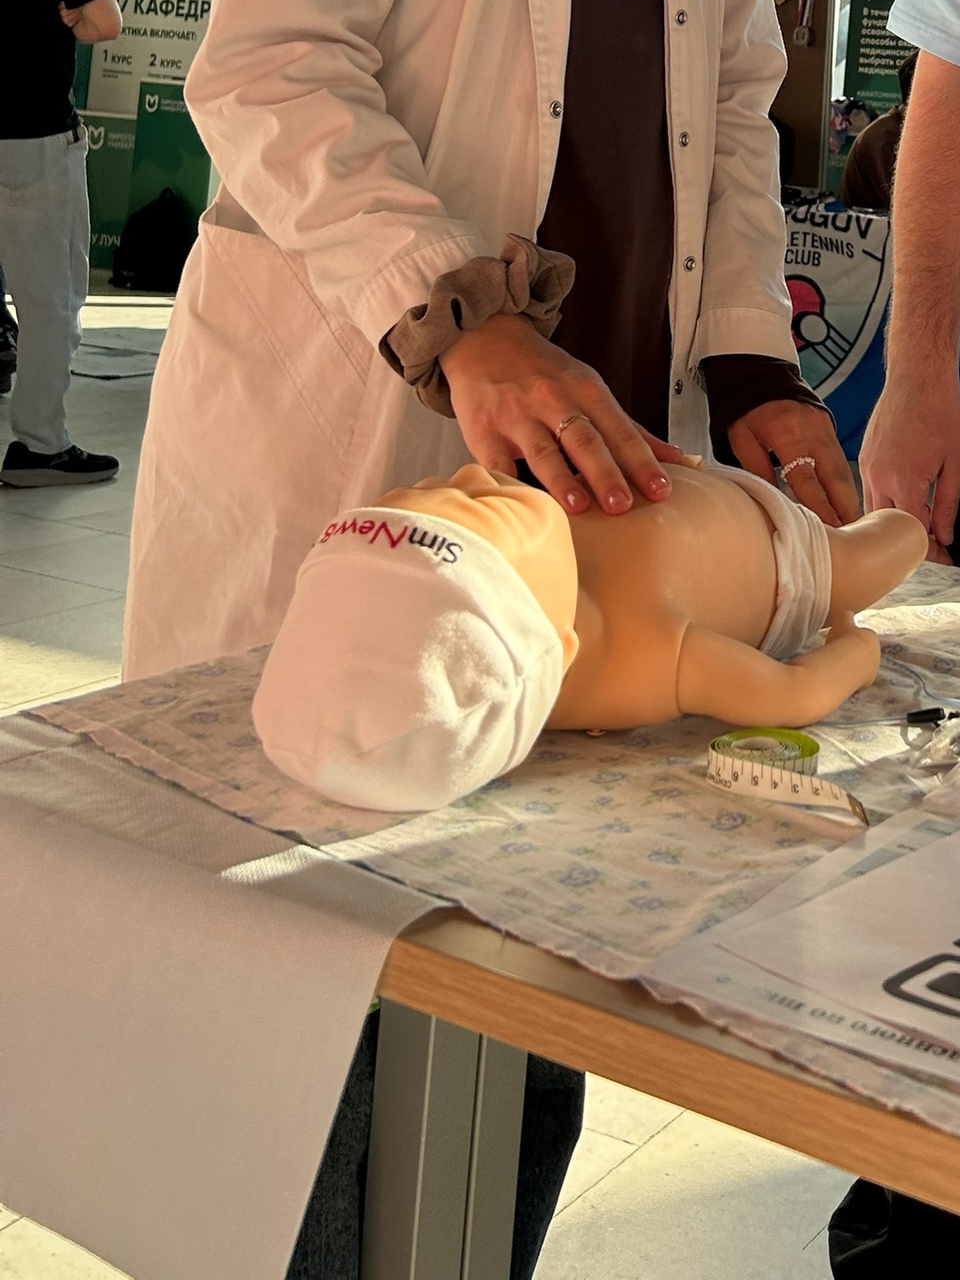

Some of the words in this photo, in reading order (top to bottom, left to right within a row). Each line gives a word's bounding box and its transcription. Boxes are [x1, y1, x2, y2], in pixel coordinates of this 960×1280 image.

[863, 7, 869, 16] В
[149, 28, 198, 41] ВКЛЮЧАЕТ:
[860, 37, 896, 47] способы
[103, 49, 108, 63] 1
[110, 53, 132, 65] КУРС
[149, 53, 157, 67] 2
[160, 58, 183, 69] КУРС
[859, 56, 895, 67] выбрать
[785, 249, 822, 267] CLUB
[733, 771, 739, 782] 6
[752, 775, 759, 786] 5
[772, 780, 779, 789] 4
[793, 783, 799, 793] 3
